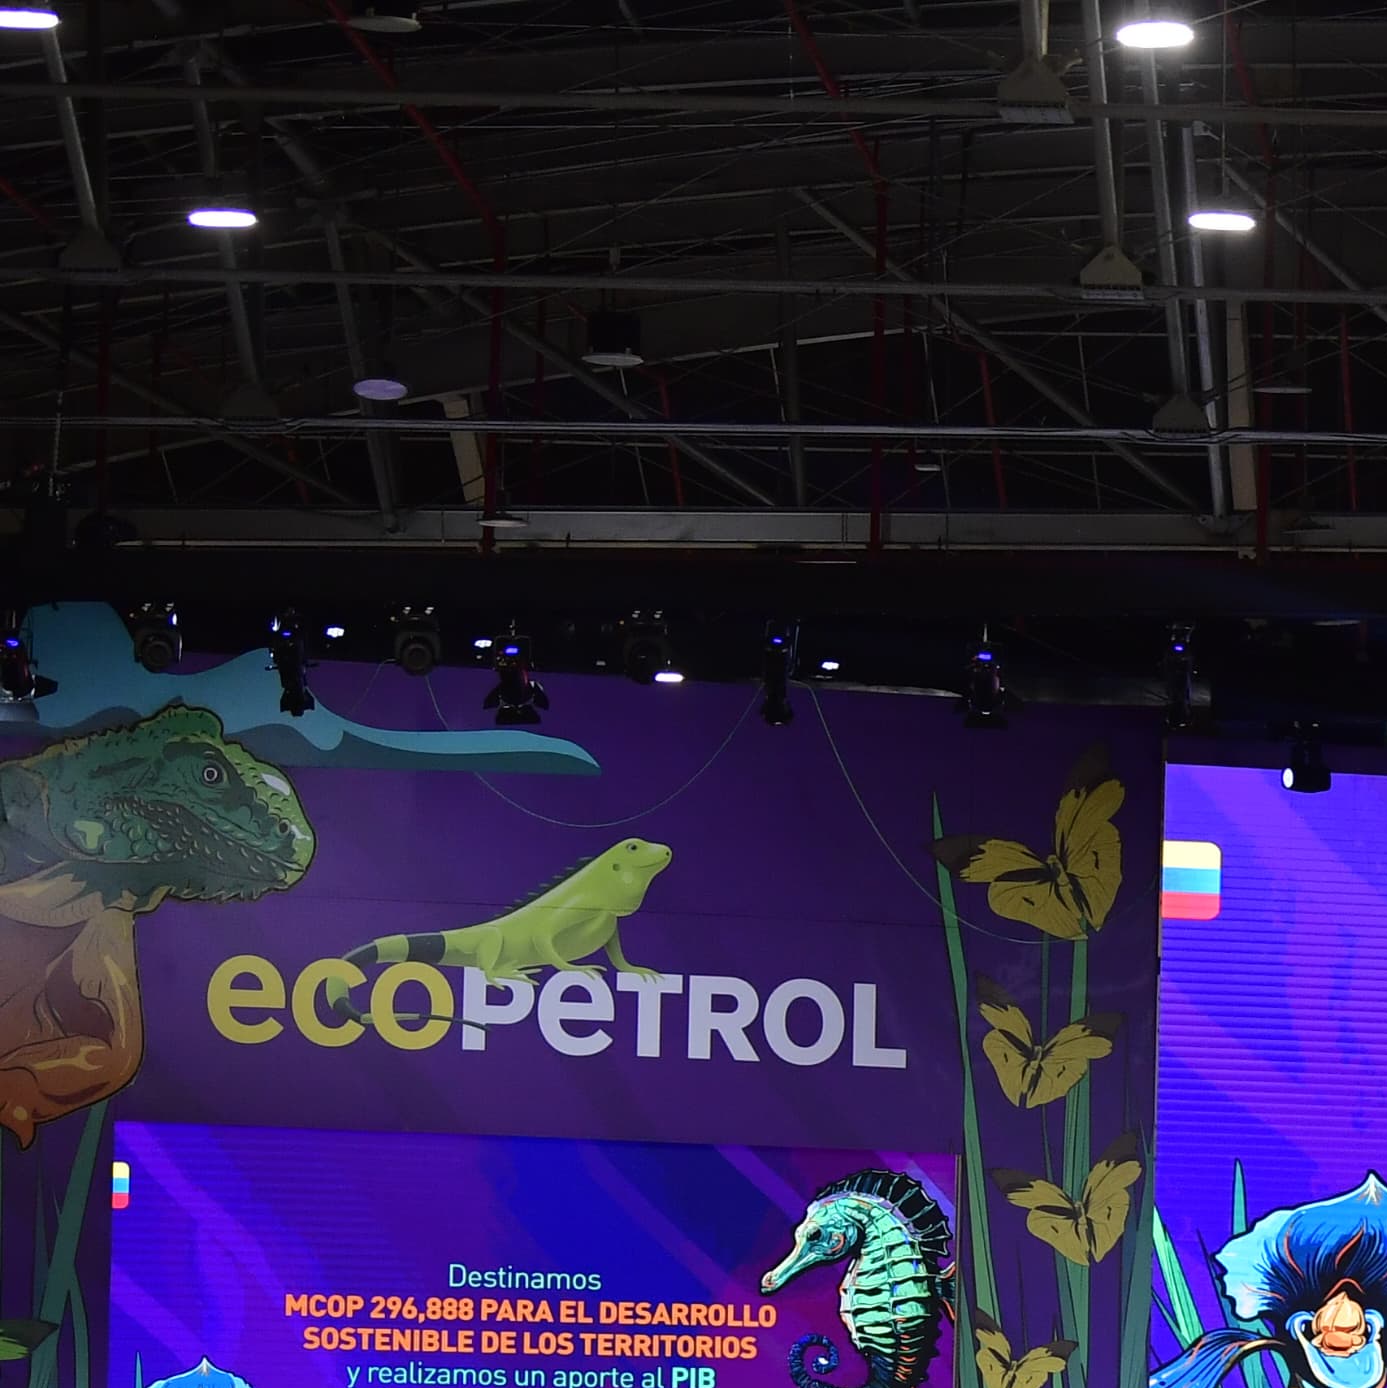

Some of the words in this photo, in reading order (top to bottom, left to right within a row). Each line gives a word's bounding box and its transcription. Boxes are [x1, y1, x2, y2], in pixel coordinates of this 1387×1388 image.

[449, 1263, 602, 1291] Destinamos
[285, 1294, 364, 1318] MCOP
[370, 1296, 474, 1323] 296,888
[480, 1298, 554, 1323] PARA
[560, 1300, 594, 1323] EL
[599, 1301, 777, 1328] DESARROLLO
[303, 1326, 474, 1353] SOSTENIBLE
[481, 1331, 517, 1354] DE
[523, 1332, 574, 1355] LOS
[579, 1333, 757, 1359] TERRITORIOS
[346, 1366, 361, 1388] y
[368, 1361, 507, 1386] realizamos
[514, 1369, 545, 1387] un
[641, 1366, 665, 1388] al
